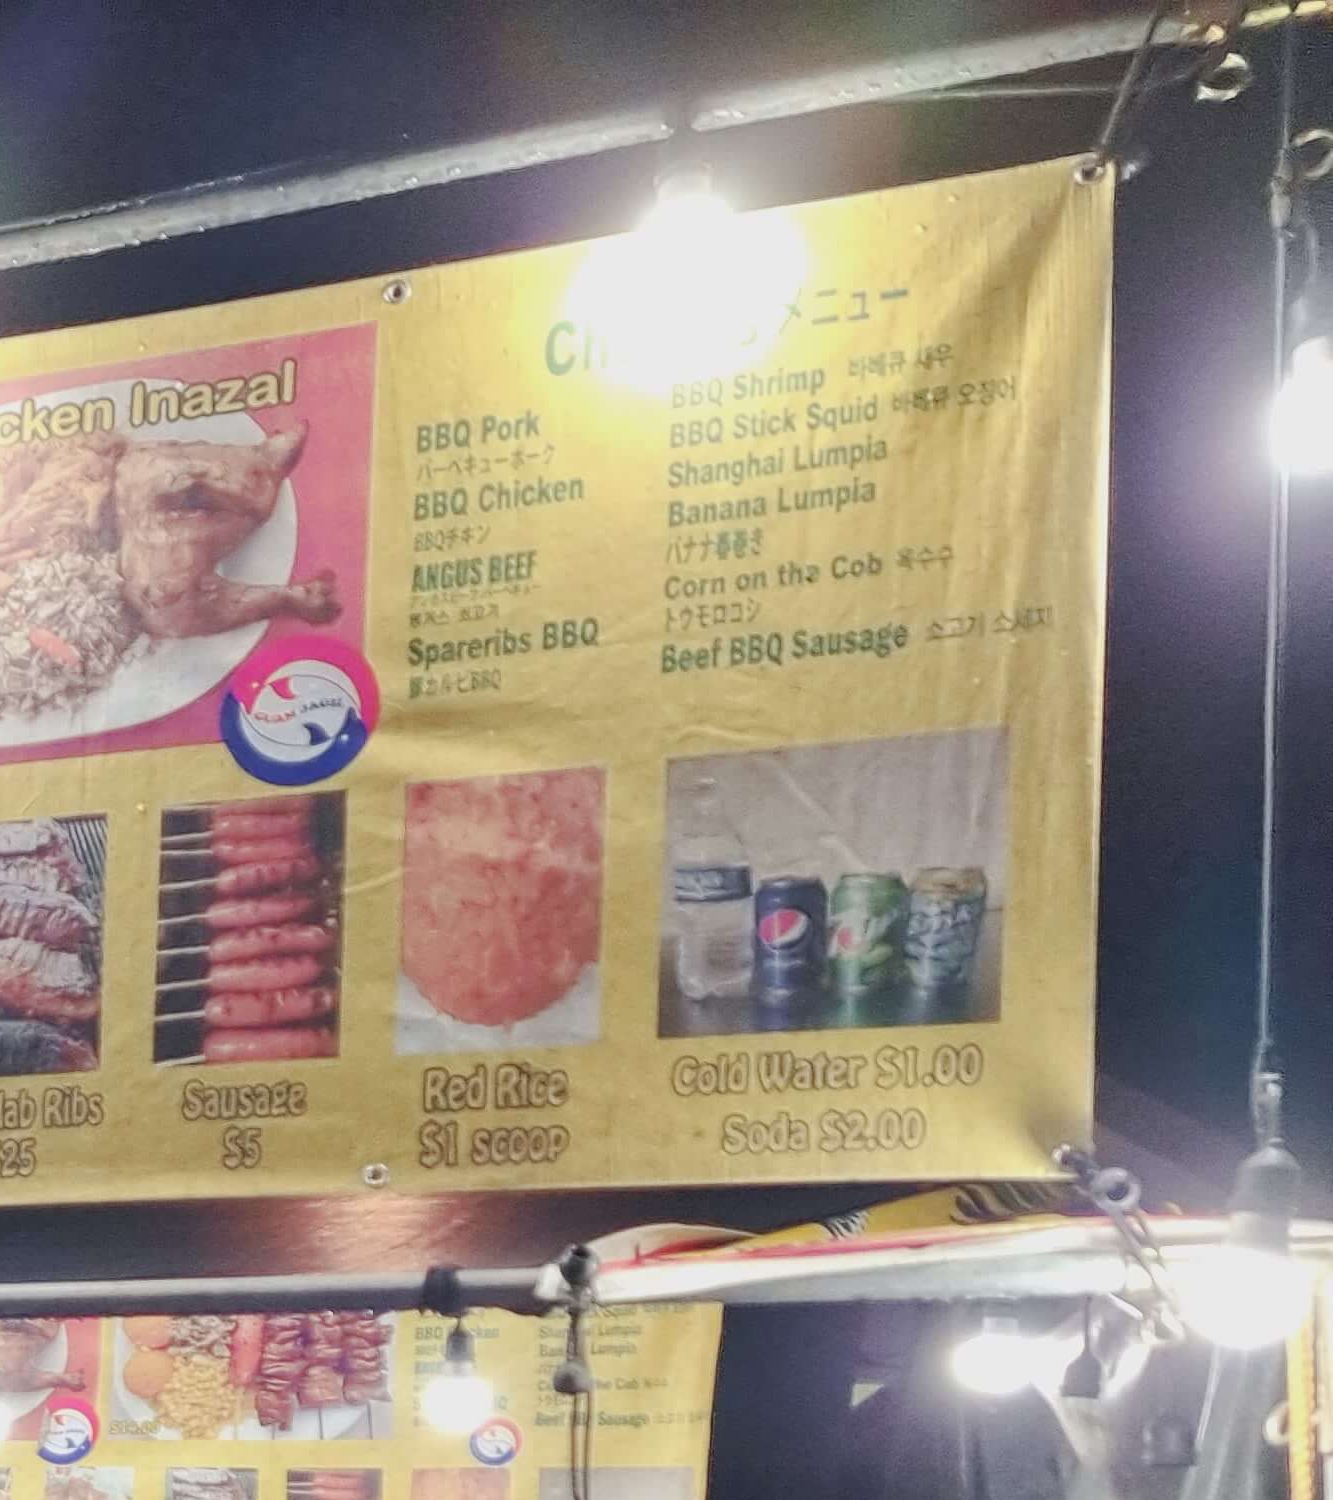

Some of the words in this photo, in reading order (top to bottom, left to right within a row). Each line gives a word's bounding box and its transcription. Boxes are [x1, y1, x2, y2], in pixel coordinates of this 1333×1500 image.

[128, 357, 299, 429] Inazal
[733, 365, 826, 403] Shrimp
[415, 418, 472, 454] BBQ
[481, 410, 541, 444] Pork
[669, 414, 724, 448] BBQ
[733, 407, 796, 440] Stick
[805, 393, 880, 432] Squid
[667, 446, 785, 489] Shanghai
[792, 433, 889, 472] Lumpia
[414, 487, 469, 521] BBQ
[478, 475, 586, 513] Chicken
[667, 494, 768, 528] Banana
[775, 475, 878, 515] Lumpia
[411, 556, 485, 593] ANGUS
[487, 549, 538, 583] BEEF
[663, 574, 726, 603] Corn
[735, 569, 768, 593] on
[776, 559, 821, 585] the
[829, 551, 884, 580] Cob
[407, 626, 534, 671] Spareribs
[541, 616, 601, 652] BBQ
[659, 637, 724, 674] Beef
[728, 631, 783, 667] BBQ
[791, 621, 911, 660] Sausage
[421, 1062, 488, 1114] Red
[493, 1060, 571, 1110] Rice
[670, 1052, 750, 1098] Cold
[756, 1047, 868, 1094] Water
[873, 1041, 986, 1091] $1.00
[41, 1083, 105, 1129] Ribs
[180, 1078, 309, 1122] Sausage
[220, 1124, 262, 1171] $5
[418, 1118, 459, 1170] $1
[469, 1123, 571, 1167] scoop
[720, 1110, 811, 1156] Soda
[817, 1107, 928, 1154] $2.00
